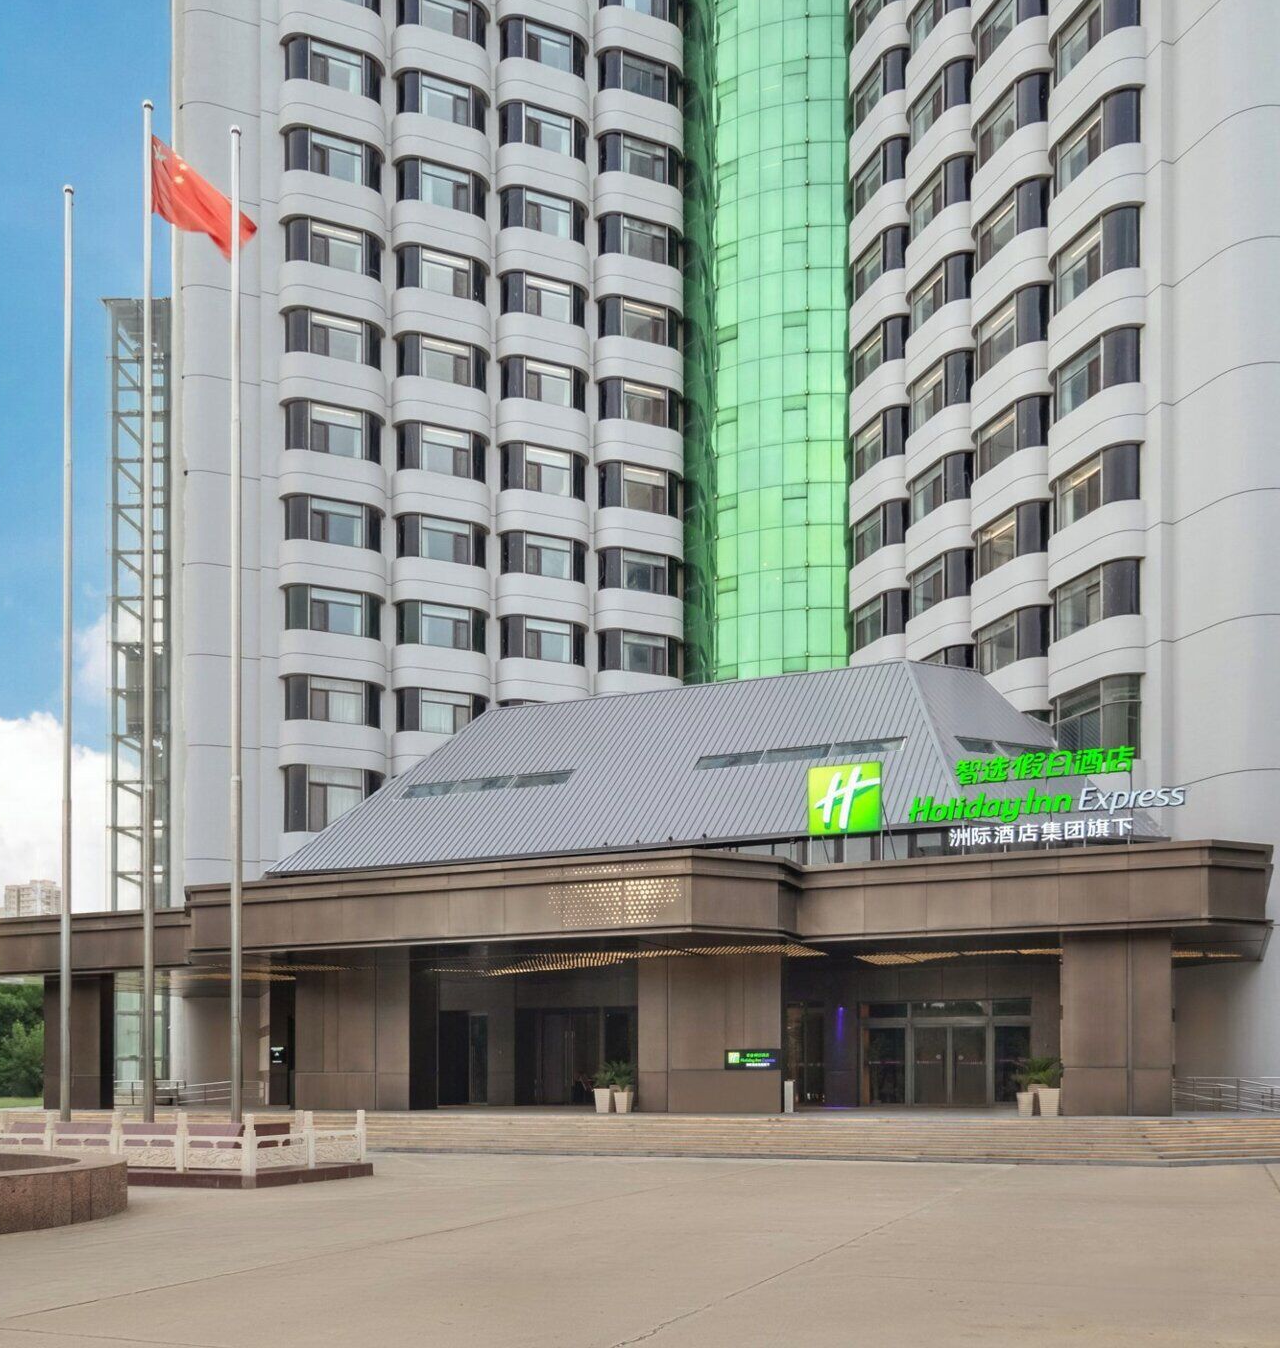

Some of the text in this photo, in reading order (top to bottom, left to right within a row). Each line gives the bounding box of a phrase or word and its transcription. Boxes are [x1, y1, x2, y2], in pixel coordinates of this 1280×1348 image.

[955, 745, 1135, 785] 智选假日酒店
[908, 786, 1186, 823] Holiday Inn Express
[949, 817, 1134, 847] 洲际酒店集团旗下
